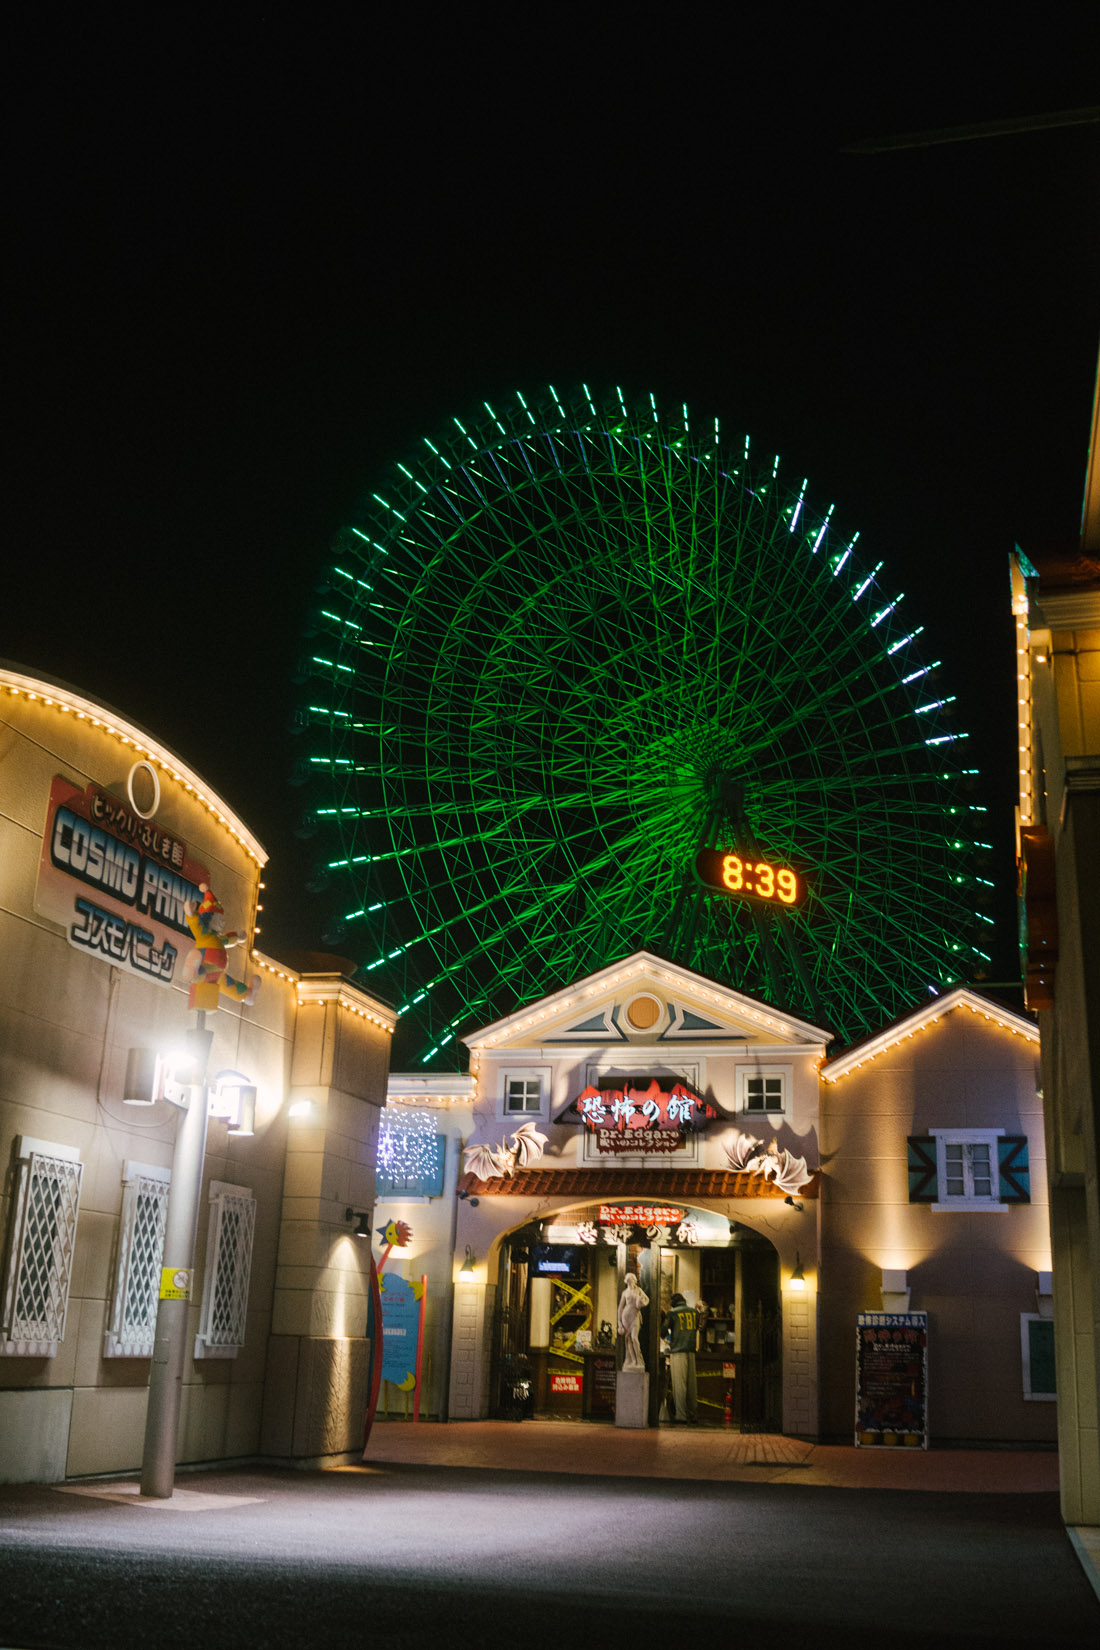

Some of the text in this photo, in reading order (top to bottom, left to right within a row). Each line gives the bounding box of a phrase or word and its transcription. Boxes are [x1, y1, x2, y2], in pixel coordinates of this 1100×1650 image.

[53, 806, 139, 898] COSMO
[722, 855, 797, 904] 8:39
[74, 899, 177, 981] コスモパニック
[581, 1095, 696, 1124] 恐怖の館
[576, 1221, 698, 1245] 恐怖の館
[677, 1312, 697, 1330] FBI
